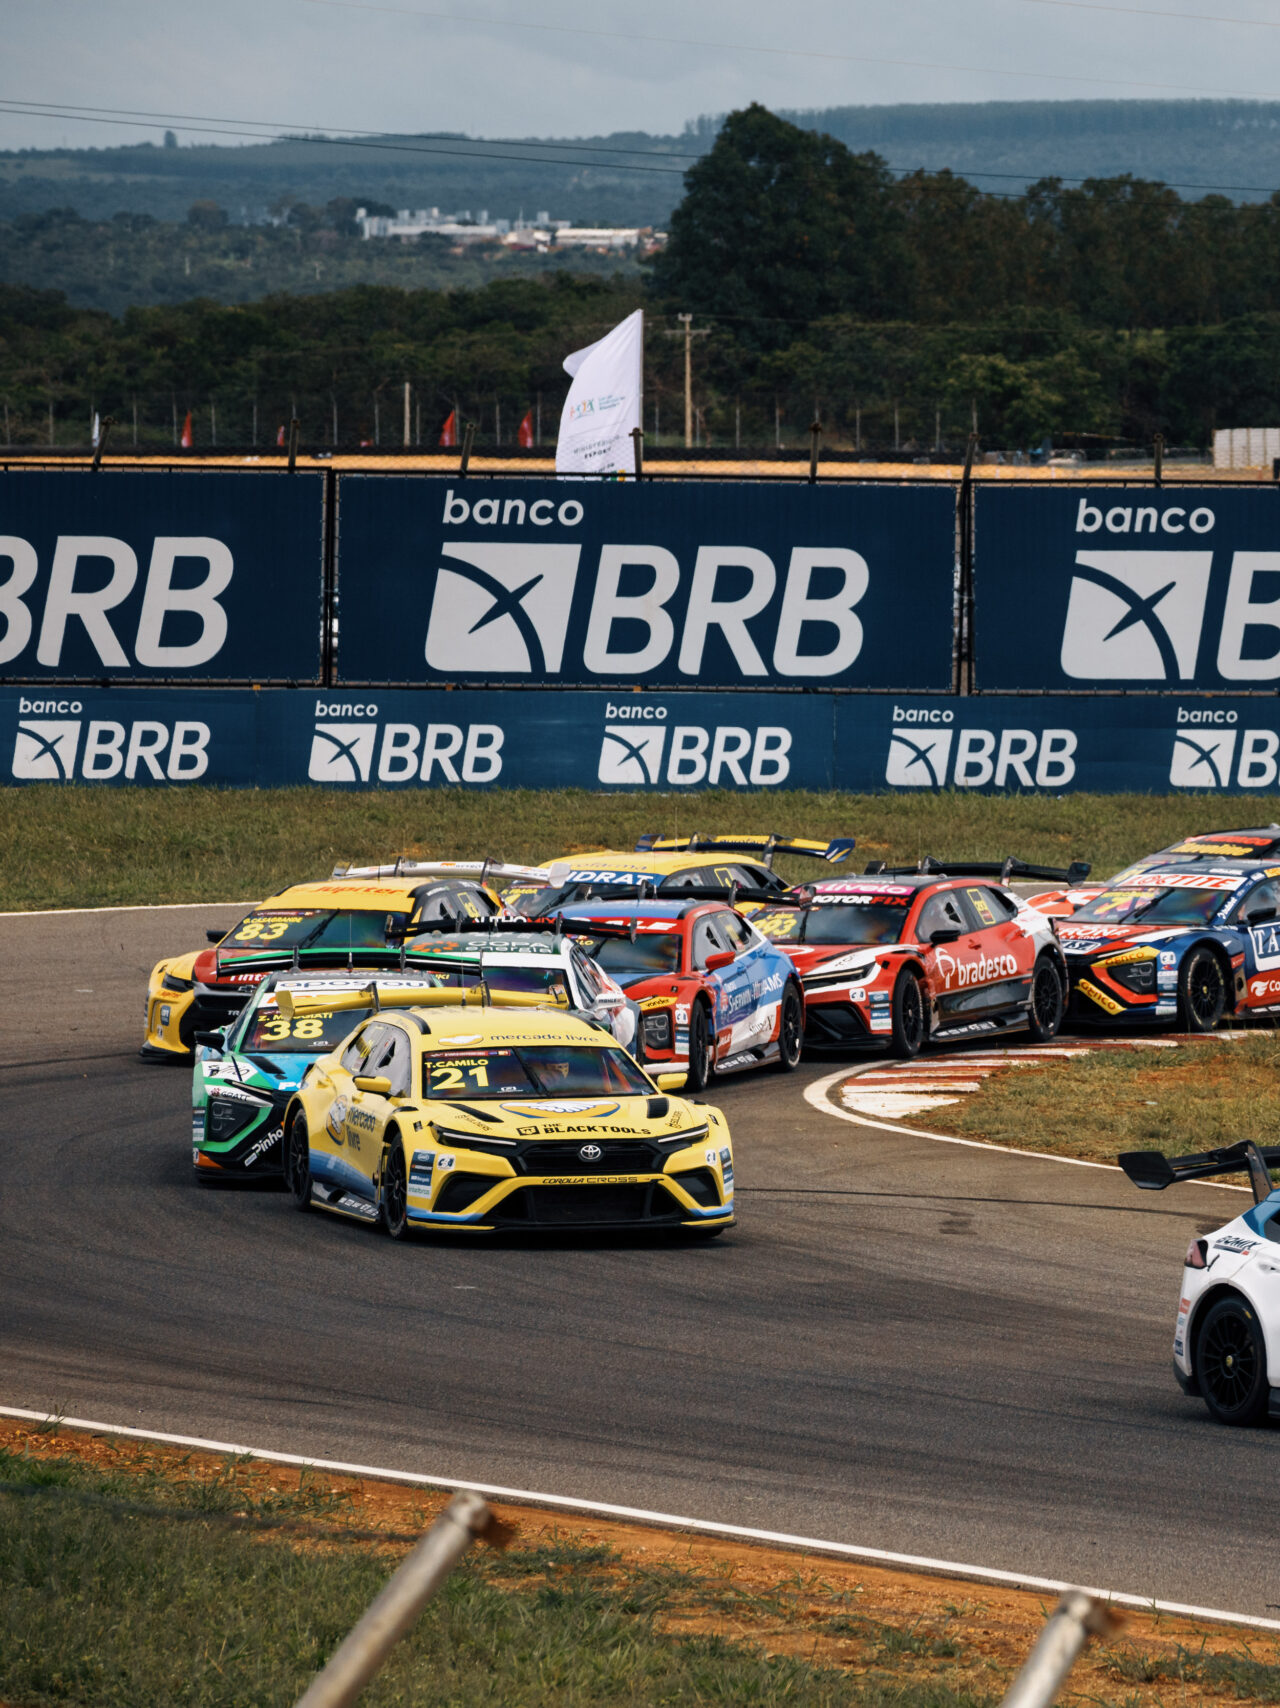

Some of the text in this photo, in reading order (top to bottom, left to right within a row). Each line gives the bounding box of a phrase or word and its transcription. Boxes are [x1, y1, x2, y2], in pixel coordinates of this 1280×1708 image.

[443, 490, 583, 534] banco
[1076, 499, 1215, 533] banco
[584, 545, 869, 676] BRB
[19, 697, 82, 713] banco
[315, 701, 378, 717] banco
[606, 703, 667, 719] banco
[893, 706, 953, 723] banco
[1178, 707, 1237, 723] banco
[82, 721, 210, 780] BRB
[378, 724, 504, 784] BRB
[667, 727, 792, 786] BRB
[954, 729, 1077, 788] BRB
[234, 922, 289, 941] 83
[957, 953, 1017, 986] bradesco
[281, 980, 424, 989] aposou
[260, 1019, 324, 1041] 38
[566, 1034, 600, 1042] livre
[424, 1059, 489, 1068] T.CAMILO
[431, 1066, 489, 1090] 21
